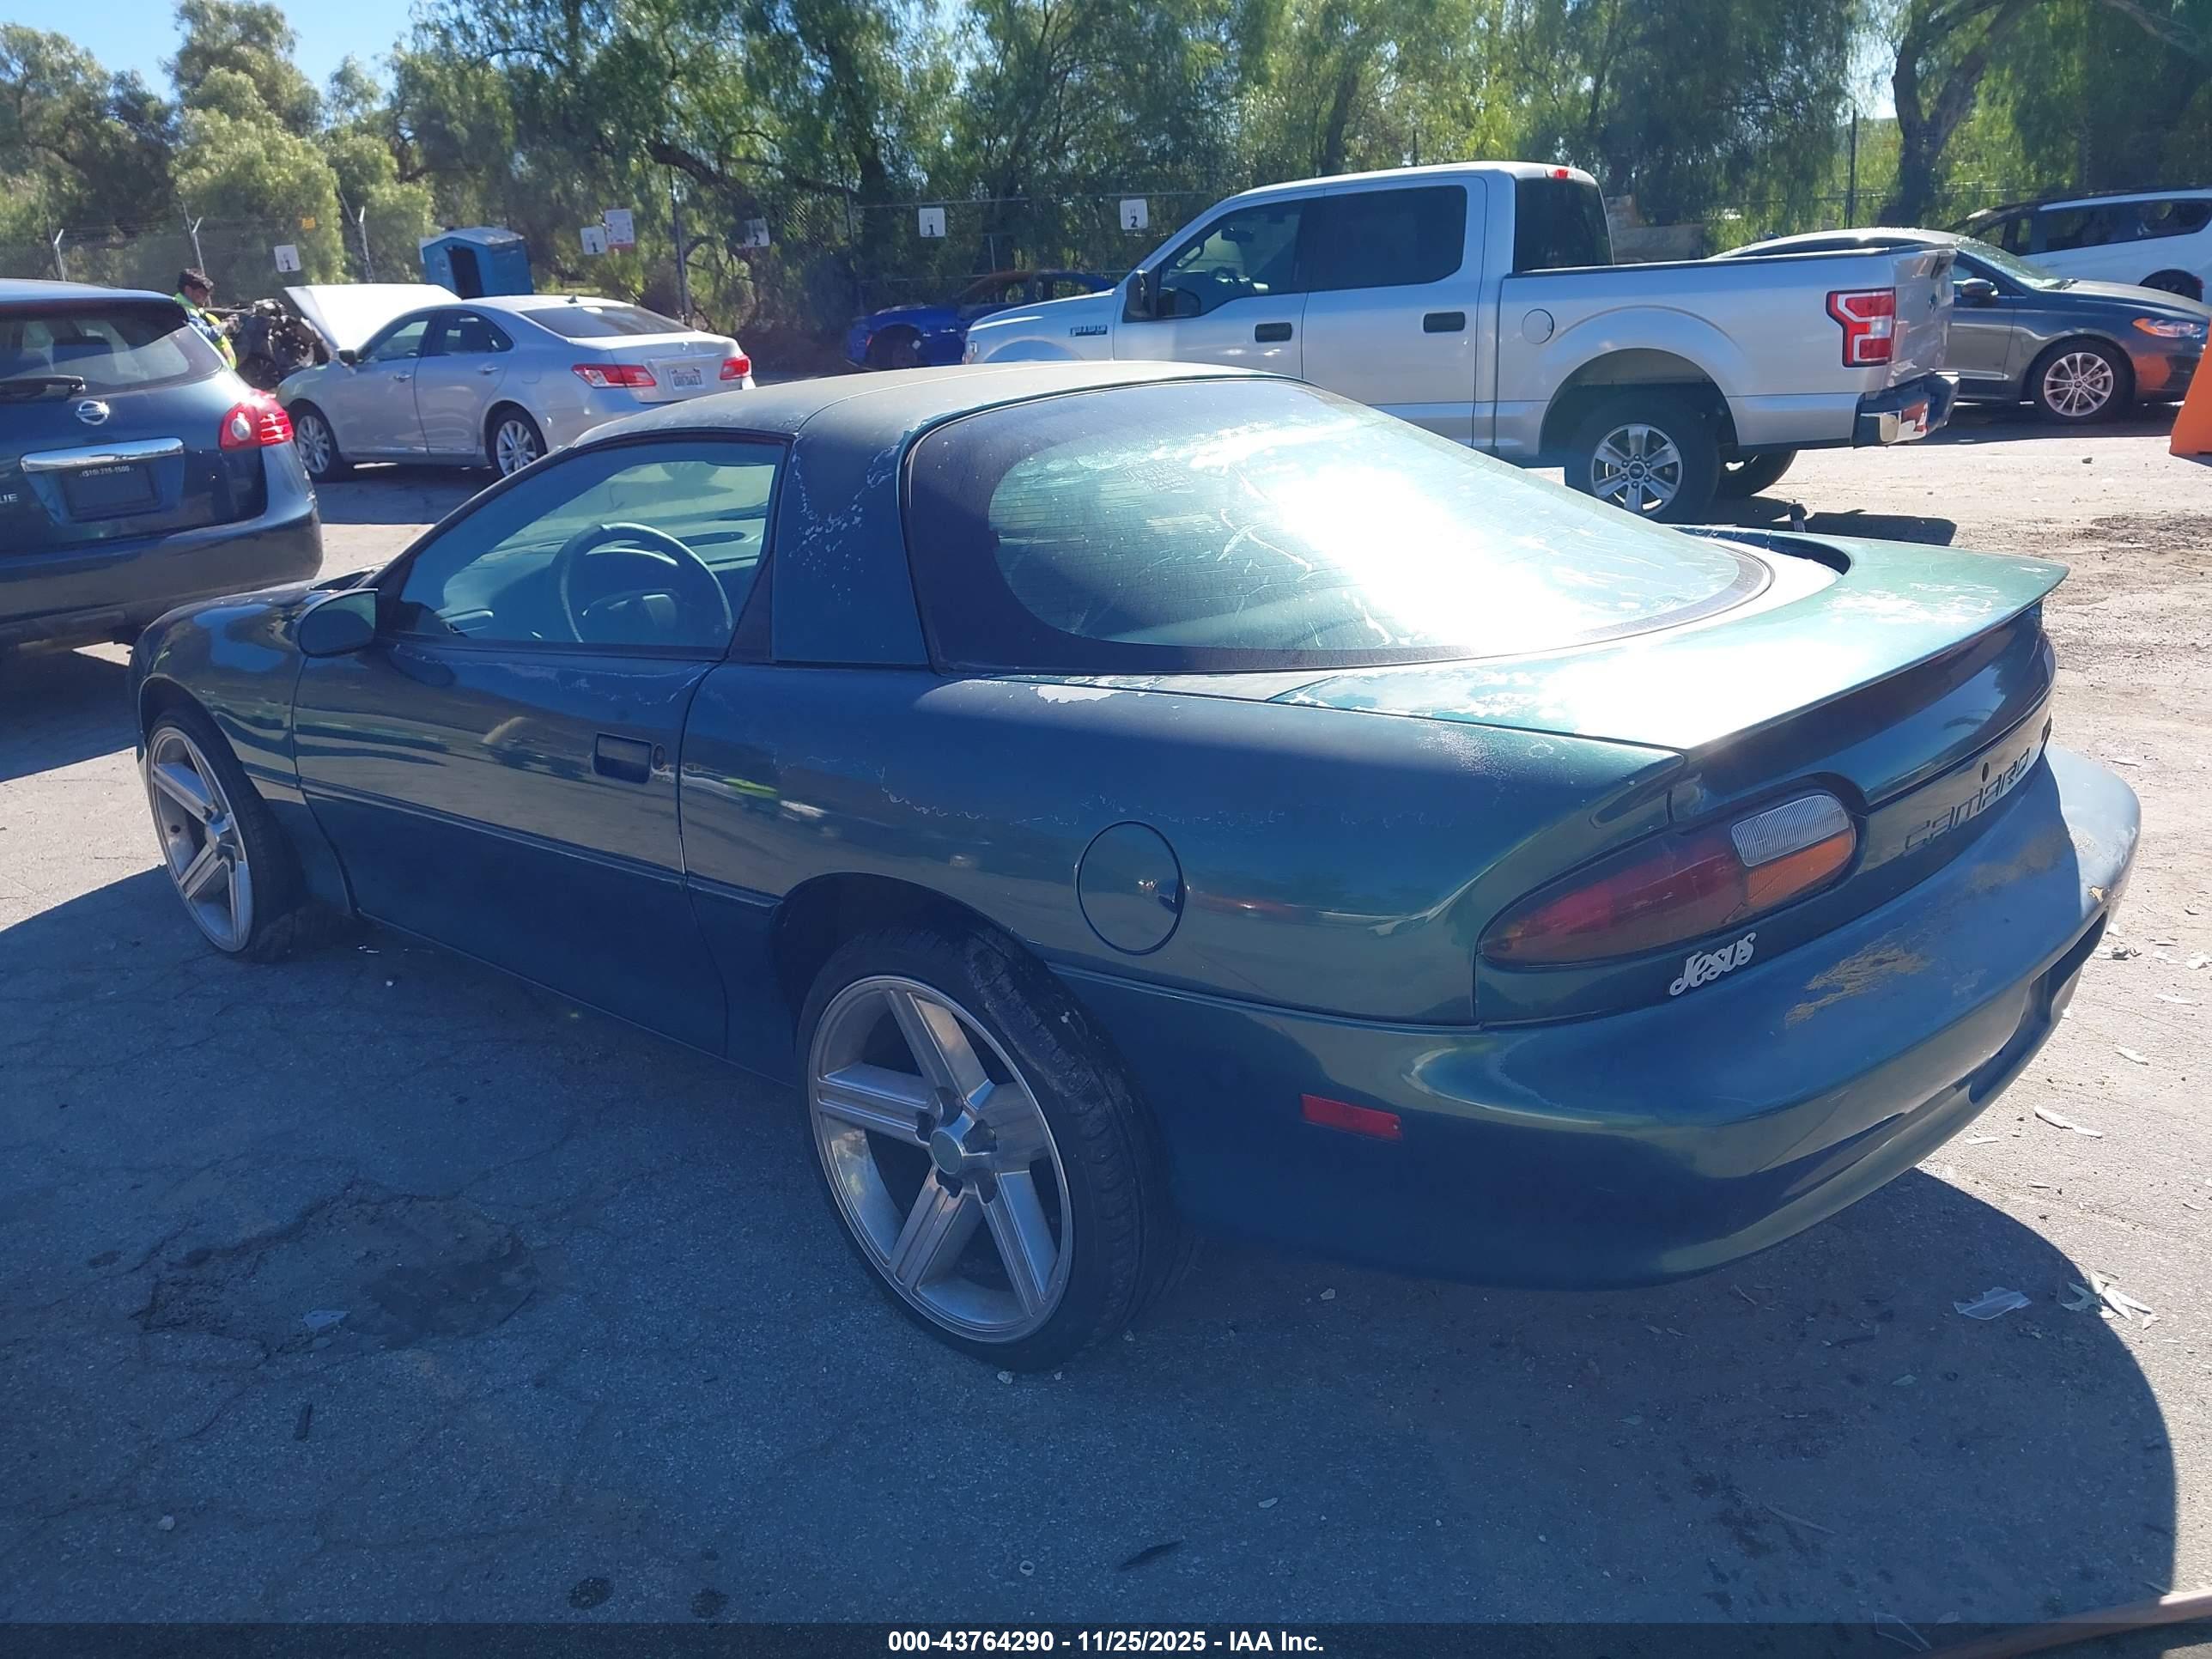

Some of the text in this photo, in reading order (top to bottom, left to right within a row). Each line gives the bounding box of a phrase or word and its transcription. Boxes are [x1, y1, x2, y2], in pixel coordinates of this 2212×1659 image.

[1130, 216, 1138, 228] 2
[928, 224, 936, 235] 1
[753, 234, 761, 246] 2
[591, 241, 599, 253] 1
[285, 259, 292, 270] 1
